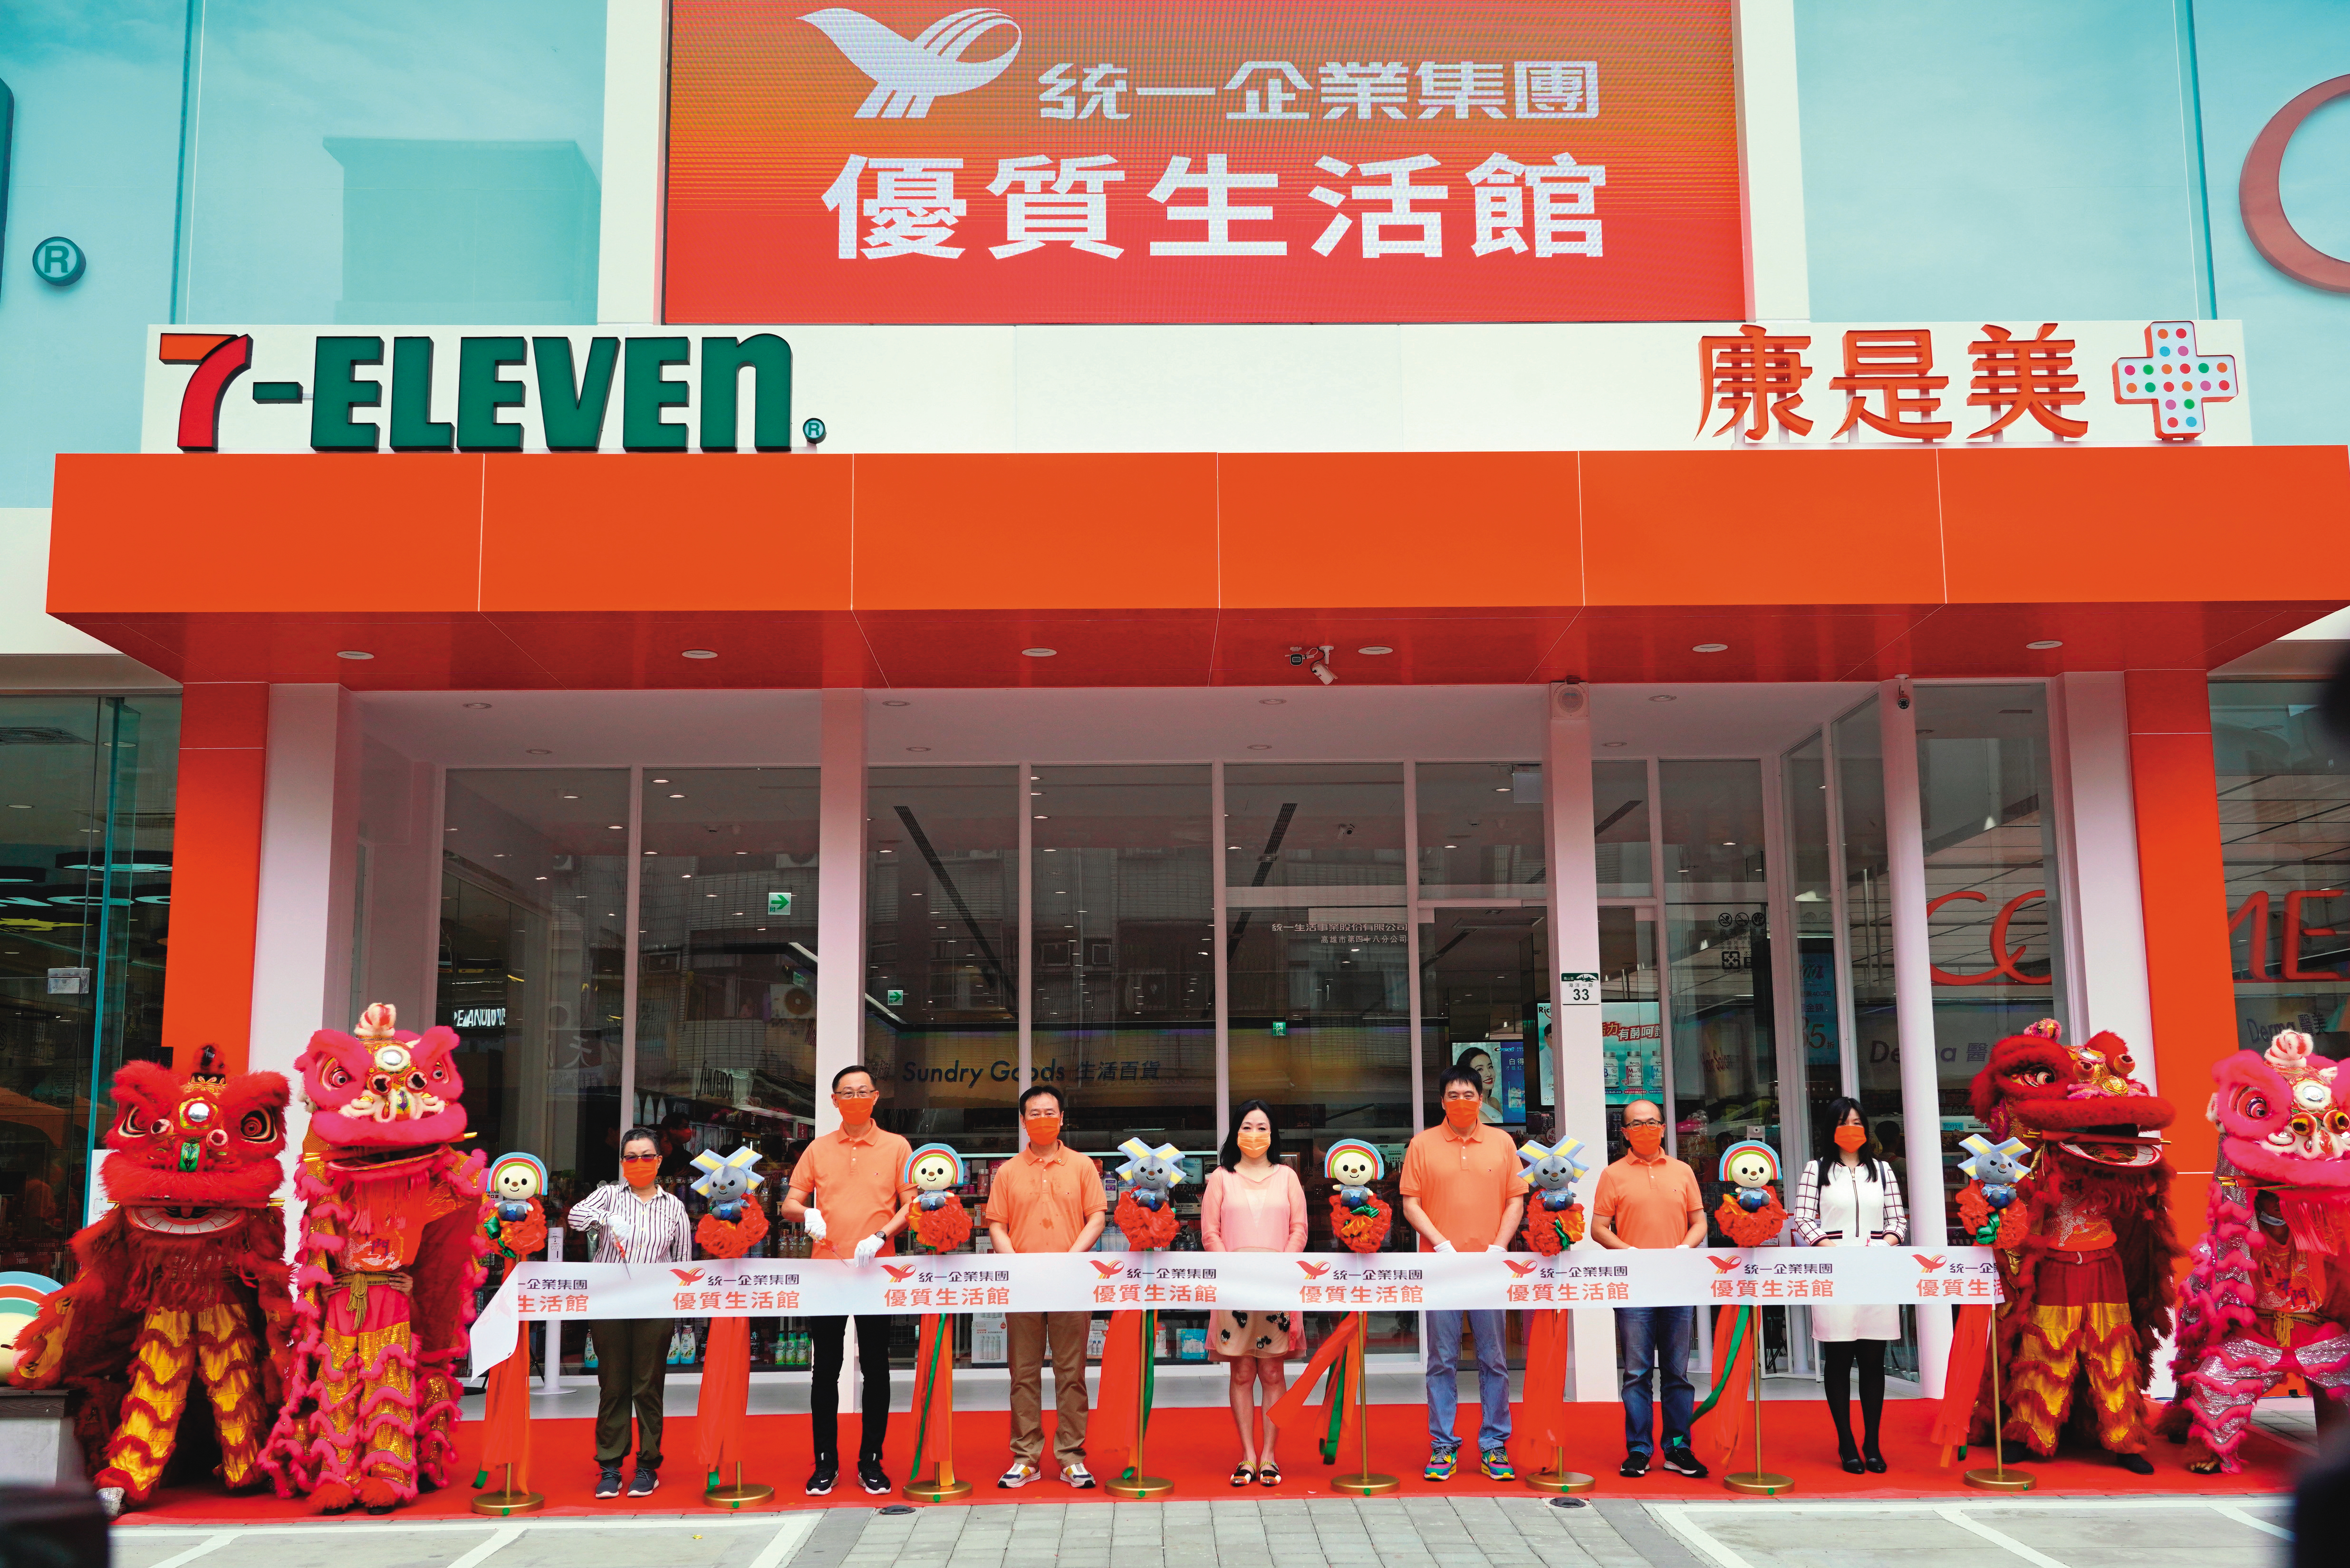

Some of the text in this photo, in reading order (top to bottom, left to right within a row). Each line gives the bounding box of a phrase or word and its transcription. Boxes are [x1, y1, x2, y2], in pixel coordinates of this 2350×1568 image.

[1037, 60, 1601, 121] 統一企業集團
[821, 151, 1606, 260] 優質生活館
[1694, 323, 2089, 441] 康是美
[1271, 923, 1408, 932] 統一生活事業股份有限公司
[1321, 935, 1407, 943] 高雄市第四十八分公司
[1573, 989, 1589, 1000] 33
[1869, 1040, 1957, 1063] Dea
[903, 1059, 983, 1088] Sundry
[1076, 1060, 1161, 1081] 生活百貨
[919, 1271, 1009, 1282] 統一企業集團
[1127, 1269, 1216, 1279] 統一企業集團
[1334, 1270, 1423, 1280] 統一企業集團
[1540, 1266, 1628, 1278] 統一企業集團
[1744, 1263, 1832, 1274] 統一企業集團
[708, 1275, 799, 1286] 統一企業集團
[1710, 1279, 1833, 1298] 優質生活館
[673, 1290, 799, 1310] 優質生活館
[884, 1287, 1010, 1307] 優質生活館
[1093, 1284, 1217, 1303] 優質生活館
[1299, 1285, 1423, 1303] 優質生活館
[1506, 1282, 1629, 1301] 優質生活館
